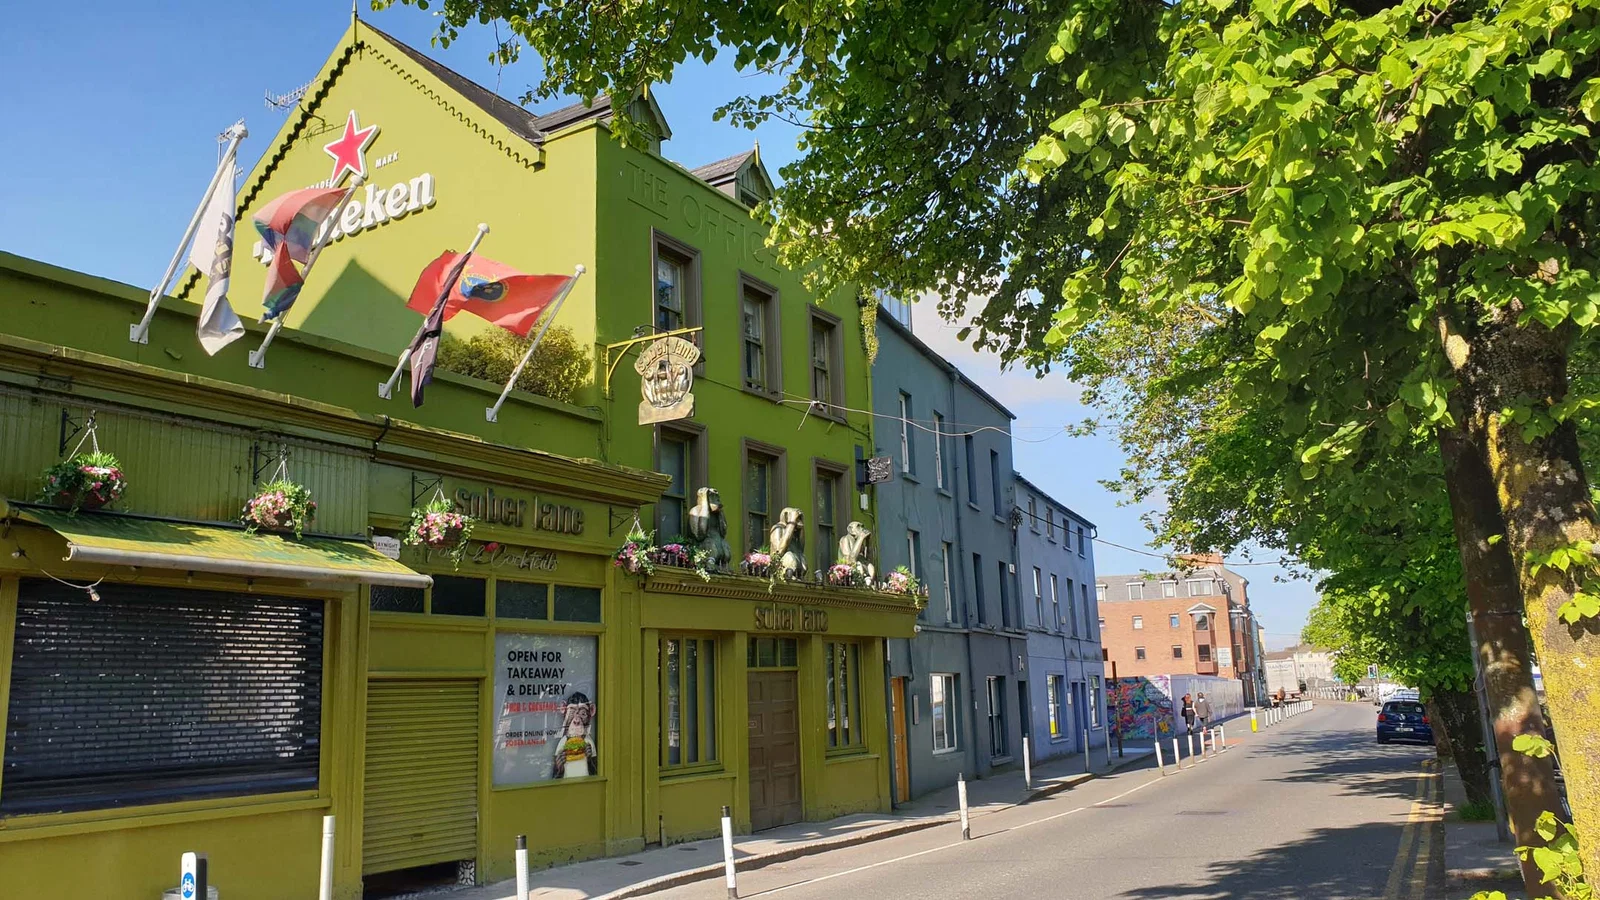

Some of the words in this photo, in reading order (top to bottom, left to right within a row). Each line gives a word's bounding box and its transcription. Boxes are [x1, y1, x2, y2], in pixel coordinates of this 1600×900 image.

[375, 152, 399, 169] MARK
[626, 160, 669, 208] THE
[253, 173, 435, 264] neken
[673, 339, 697, 364] lane
[534, 496, 584, 535] lane
[800, 605, 829, 632] lane
[507, 650, 538, 662] OPEN
[541, 651, 562, 663] FOR
[507, 667, 565, 679] TAKEAWAY
[507, 684, 515, 696] &
[519, 684, 567, 696] DELIVERY
